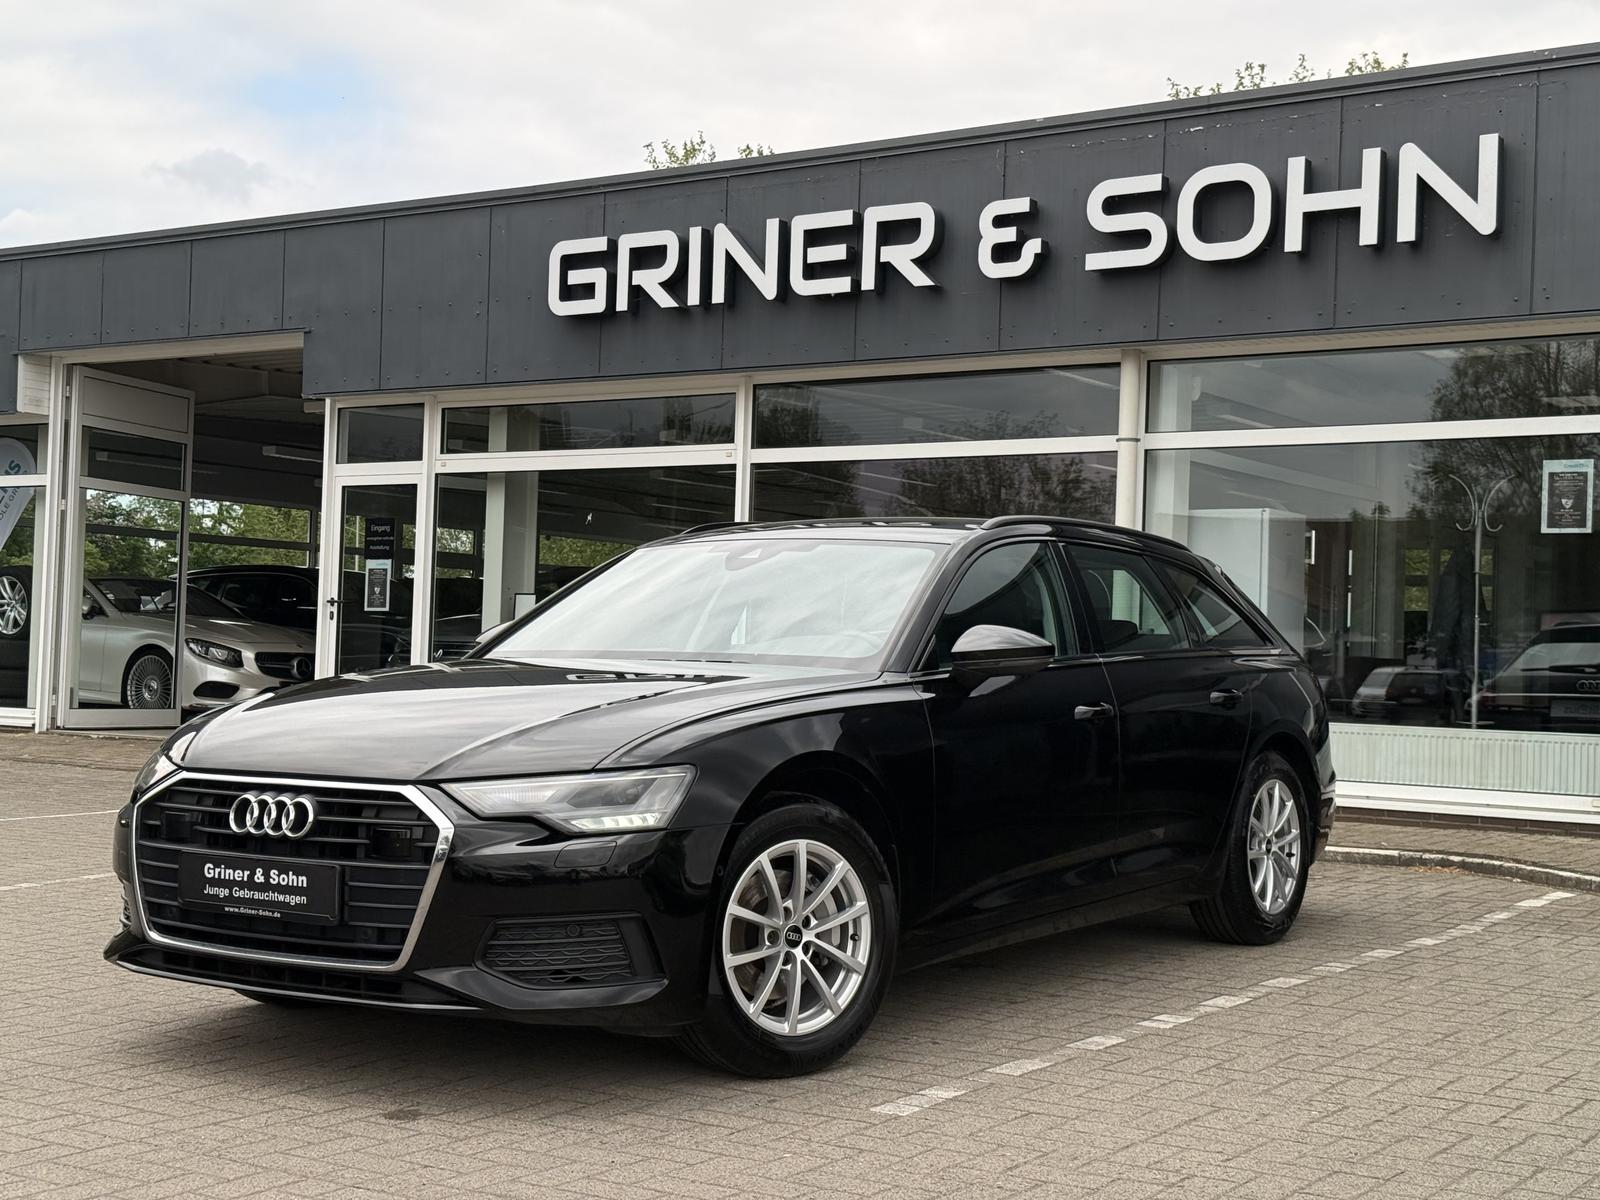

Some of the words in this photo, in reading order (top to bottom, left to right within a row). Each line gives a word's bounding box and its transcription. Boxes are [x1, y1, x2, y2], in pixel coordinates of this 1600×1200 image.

[548, 202, 936, 316] GRINER
[978, 197, 1042, 278] &
[1085, 133, 1499, 270] SOHN
[204, 863, 250, 882] Griner
[254, 868, 265, 883] &
[269, 869, 307, 887] Sohn
[204, 884, 229, 897] Junge
[232, 887, 307, 905] Gebrauchtwagen
[224, 906, 281, 918] www.Griner-Sohn.de
